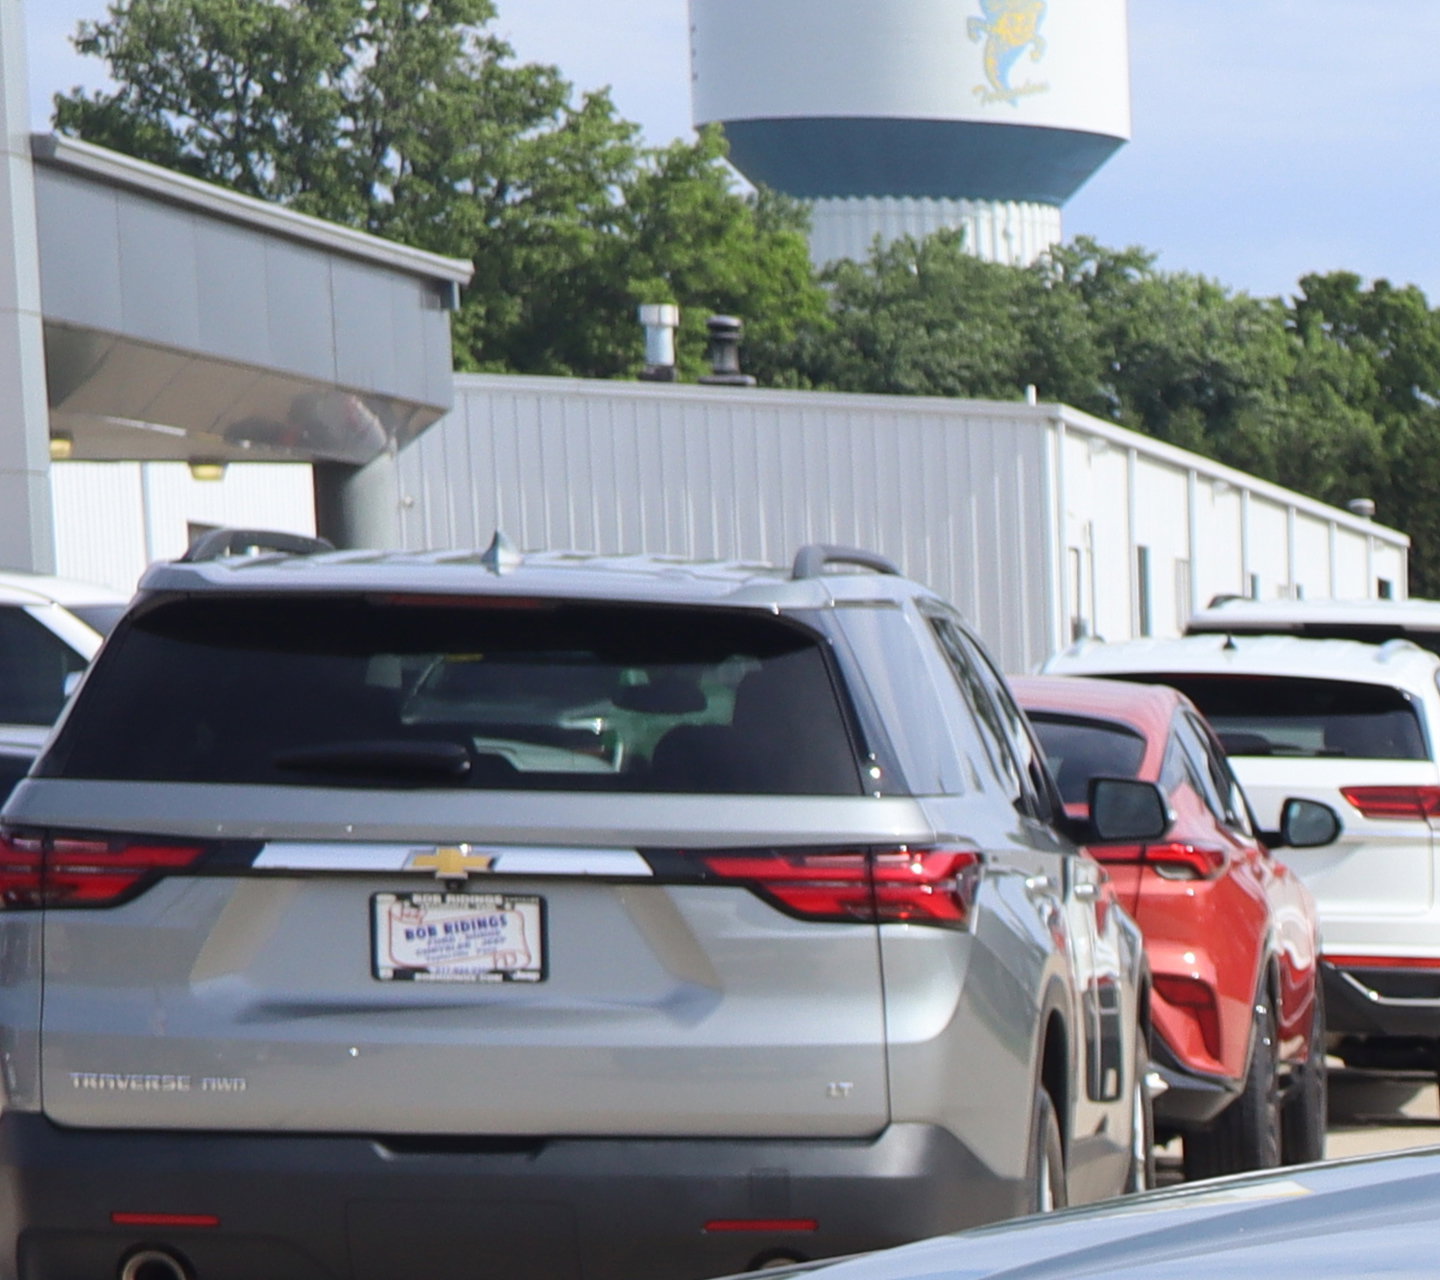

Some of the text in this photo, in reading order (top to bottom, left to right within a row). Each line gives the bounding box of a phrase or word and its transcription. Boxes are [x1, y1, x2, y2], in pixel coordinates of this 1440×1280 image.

[404, 914, 508, 941] BOB RIDINGS
[68, 1072, 192, 1092] TRAVERSE
